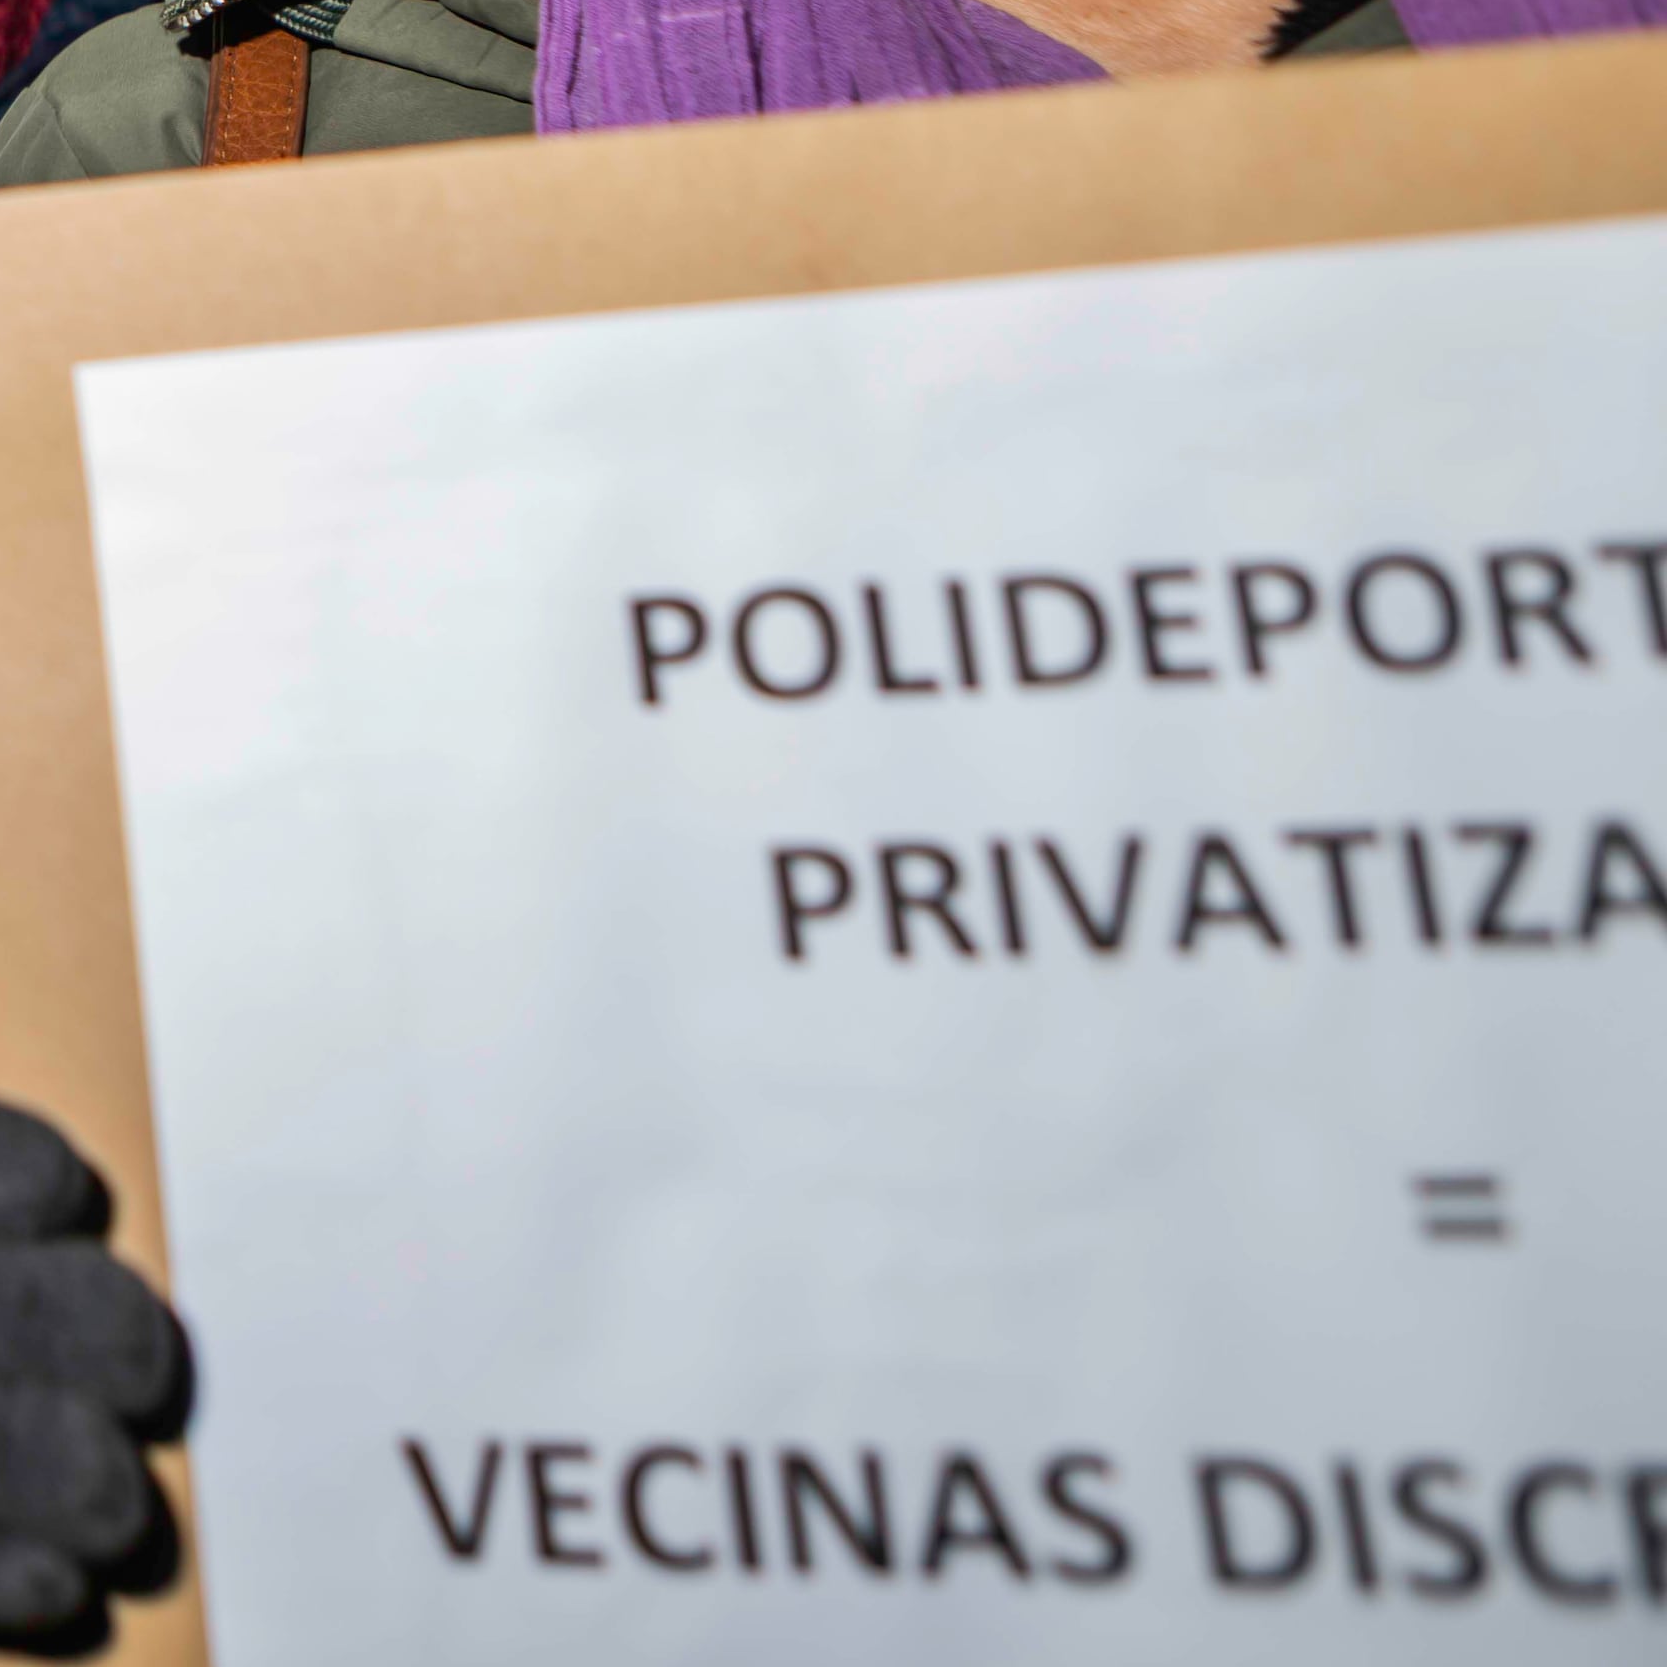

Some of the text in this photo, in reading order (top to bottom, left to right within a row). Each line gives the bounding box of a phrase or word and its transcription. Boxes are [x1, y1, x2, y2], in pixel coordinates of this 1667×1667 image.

[623, 537, 1667, 709] POLIDEPORT
[766, 813, 1667, 963] PRIVATIZA
[395, 1438, 1137, 1588] VECINAS
